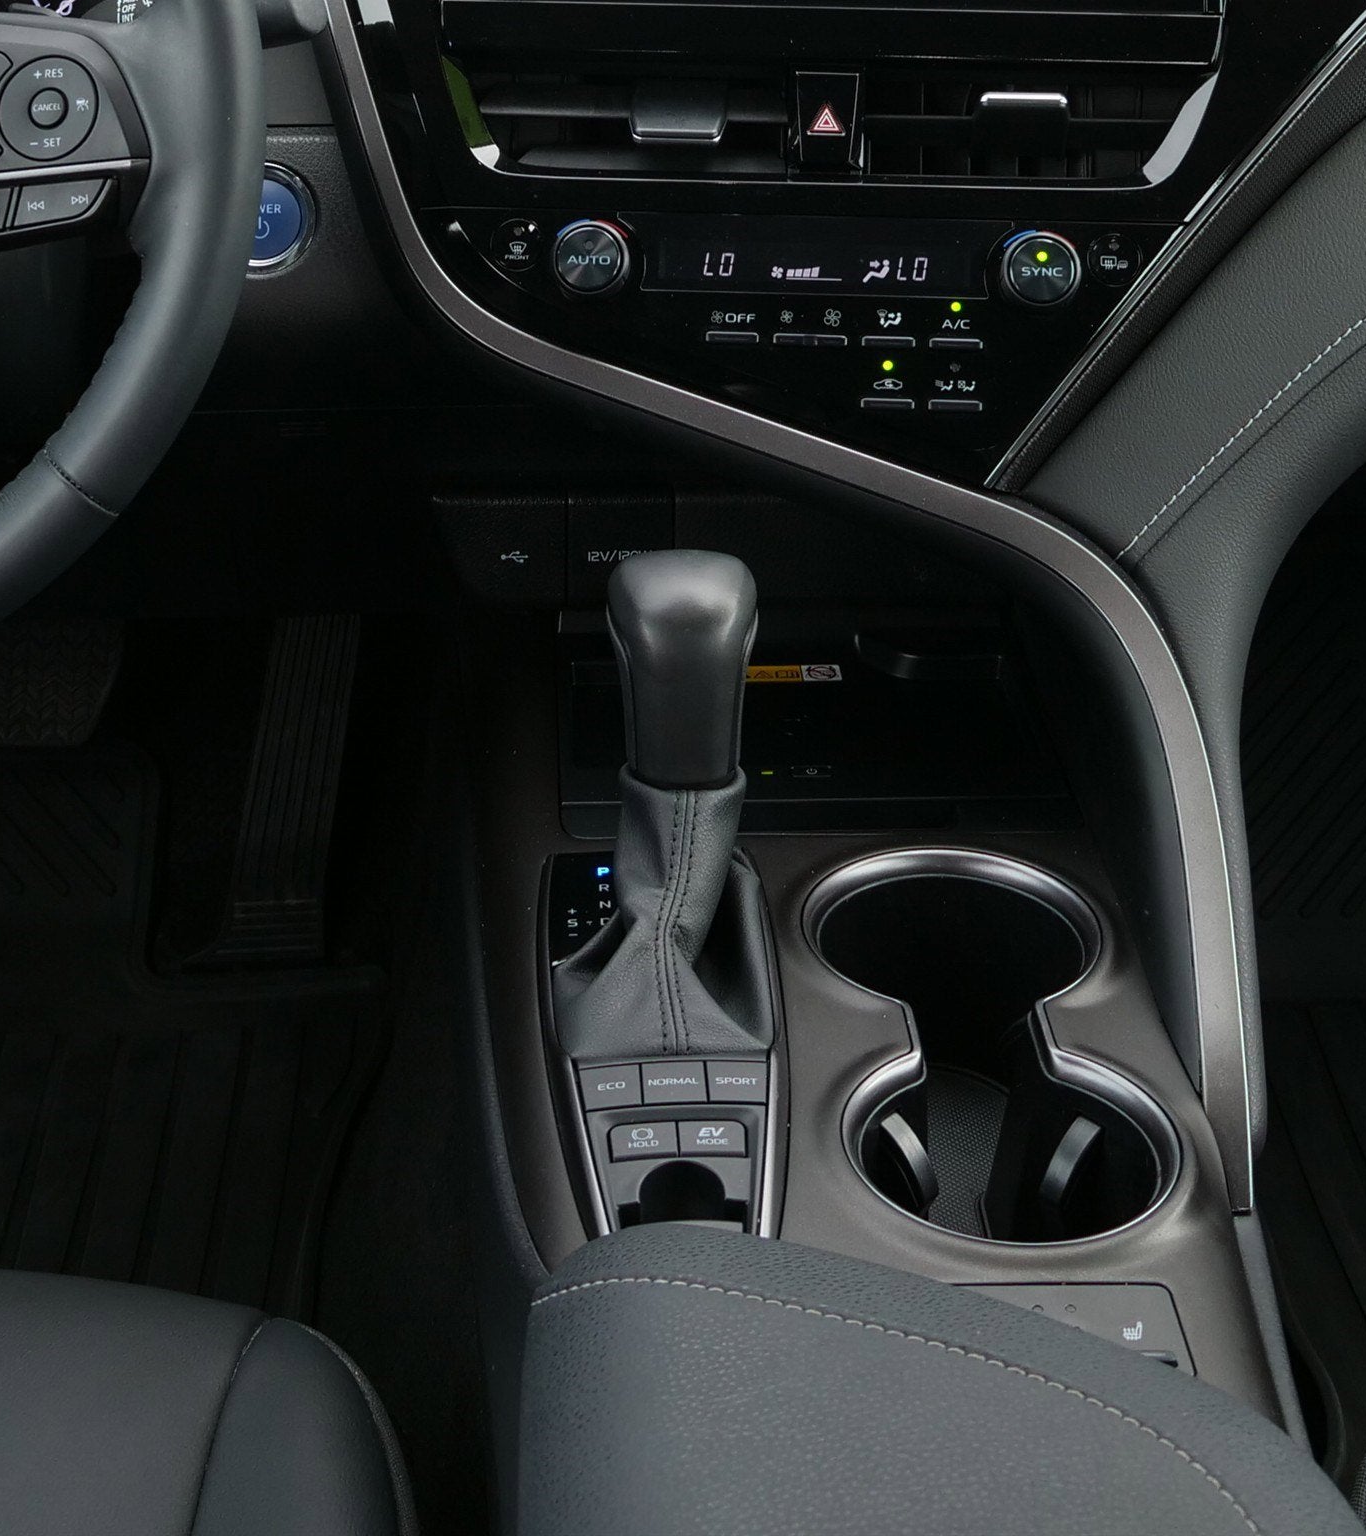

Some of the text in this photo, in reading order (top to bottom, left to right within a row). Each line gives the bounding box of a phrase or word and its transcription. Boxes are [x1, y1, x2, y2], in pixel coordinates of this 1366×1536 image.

[122, 4, 136, 13] OFF
[122, 14, 134, 22] INT
[45, 69, 64, 79] RES
[33, 102, 61, 112] CANCEL
[43, 137, 61, 148] SET
[567, 255, 611, 265] AUTO
[1021, 266, 1063, 277] SYNC
[725, 314, 756, 324] OFF
[942, 318, 971, 330] A/C
[588, 550, 652, 562] 12V/12
[597, 867, 610, 876] P
[598, 884, 610, 892] R
[599, 900, 611, 909] N
[567, 918, 578, 928] S
[597, 1075, 758, 1091] ECO NORMAL SPORT
[698, 1127, 724, 1137] EV
[628, 1138, 659, 1149] HOLD
[696, 1136, 729, 1146] MODE
